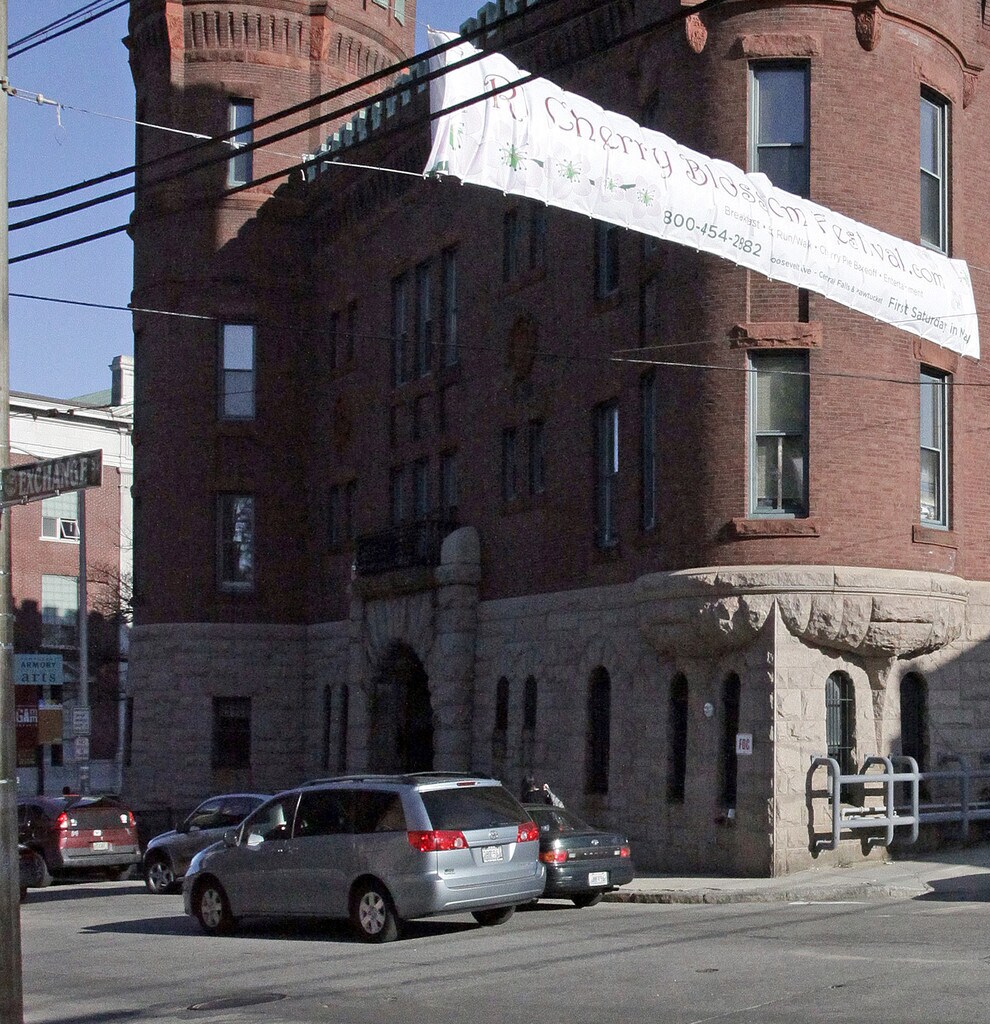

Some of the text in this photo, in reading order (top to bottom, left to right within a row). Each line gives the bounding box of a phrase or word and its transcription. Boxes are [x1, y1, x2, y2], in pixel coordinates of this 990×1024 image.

[545, 97, 672, 179] Cherry
[888, 296, 909, 316] First
[950, 322, 957, 335] in
[19, 457, 88, 494] EXCHANGE
[21, 673, 56, 683] arts
